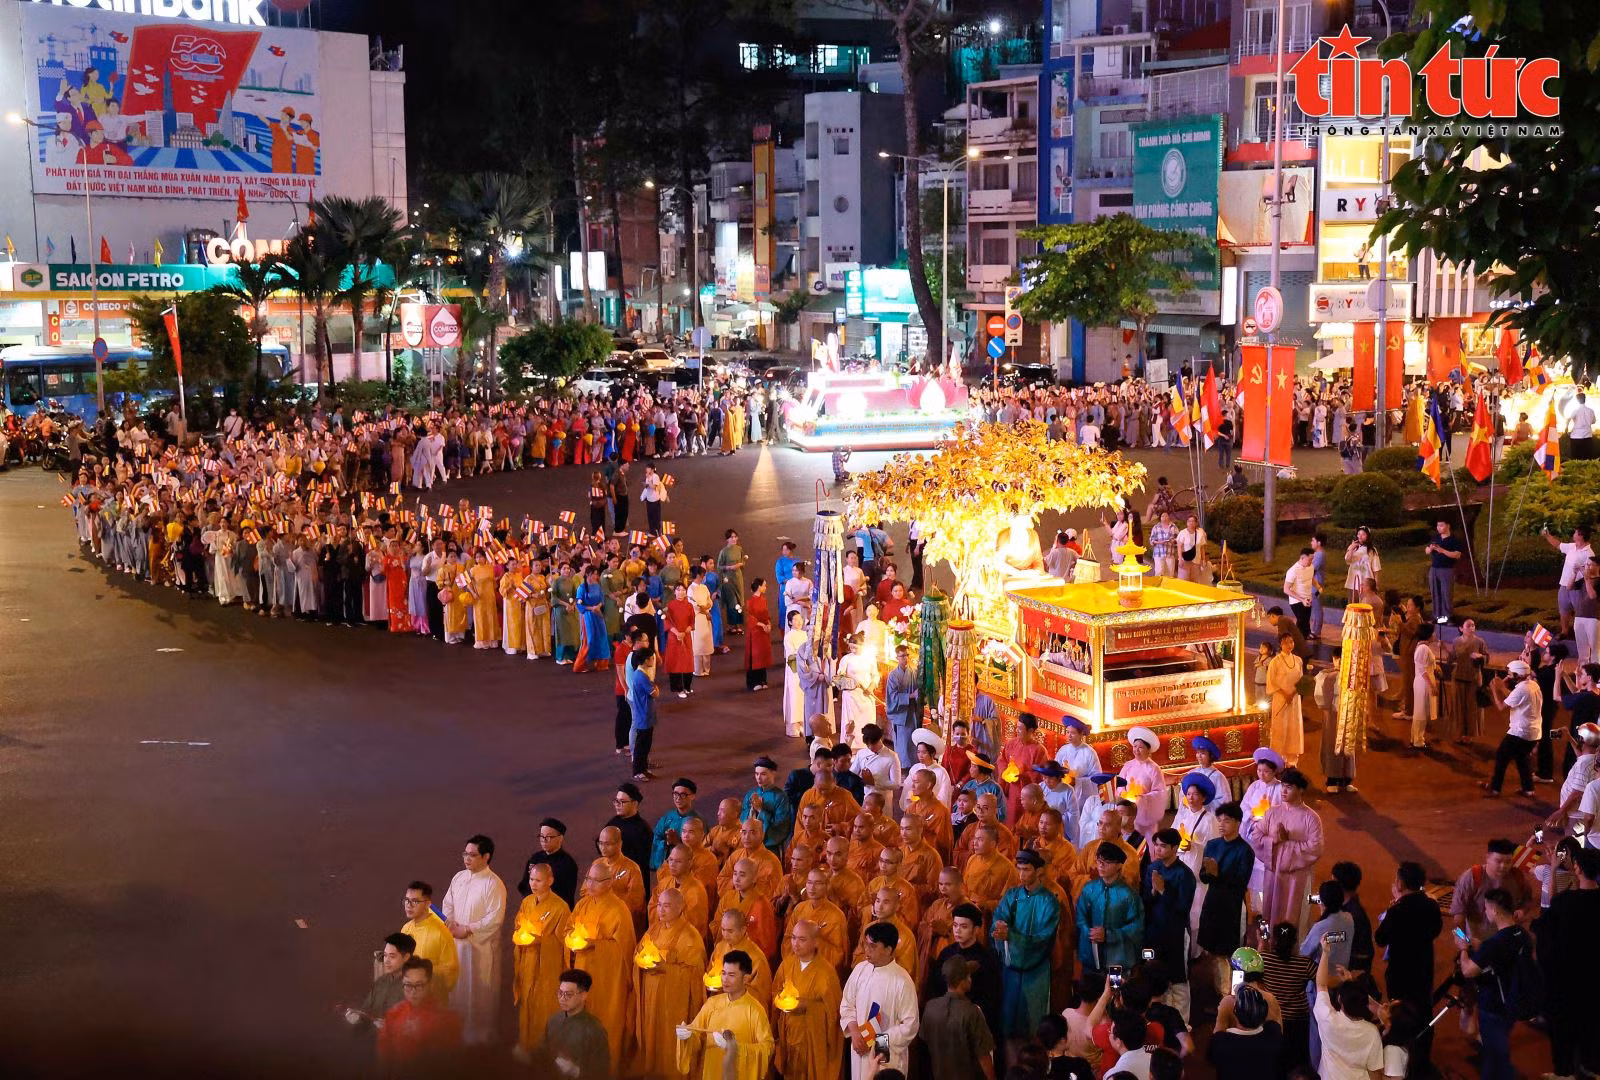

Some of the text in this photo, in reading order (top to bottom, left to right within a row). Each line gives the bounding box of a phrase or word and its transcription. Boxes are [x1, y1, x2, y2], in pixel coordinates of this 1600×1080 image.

[46, 166, 66, 176] PHÁT
[69, 168, 85, 178] HUY
[128, 184, 146, 193] NAM
[56, 272, 184, 288] SAIGON PETRO
